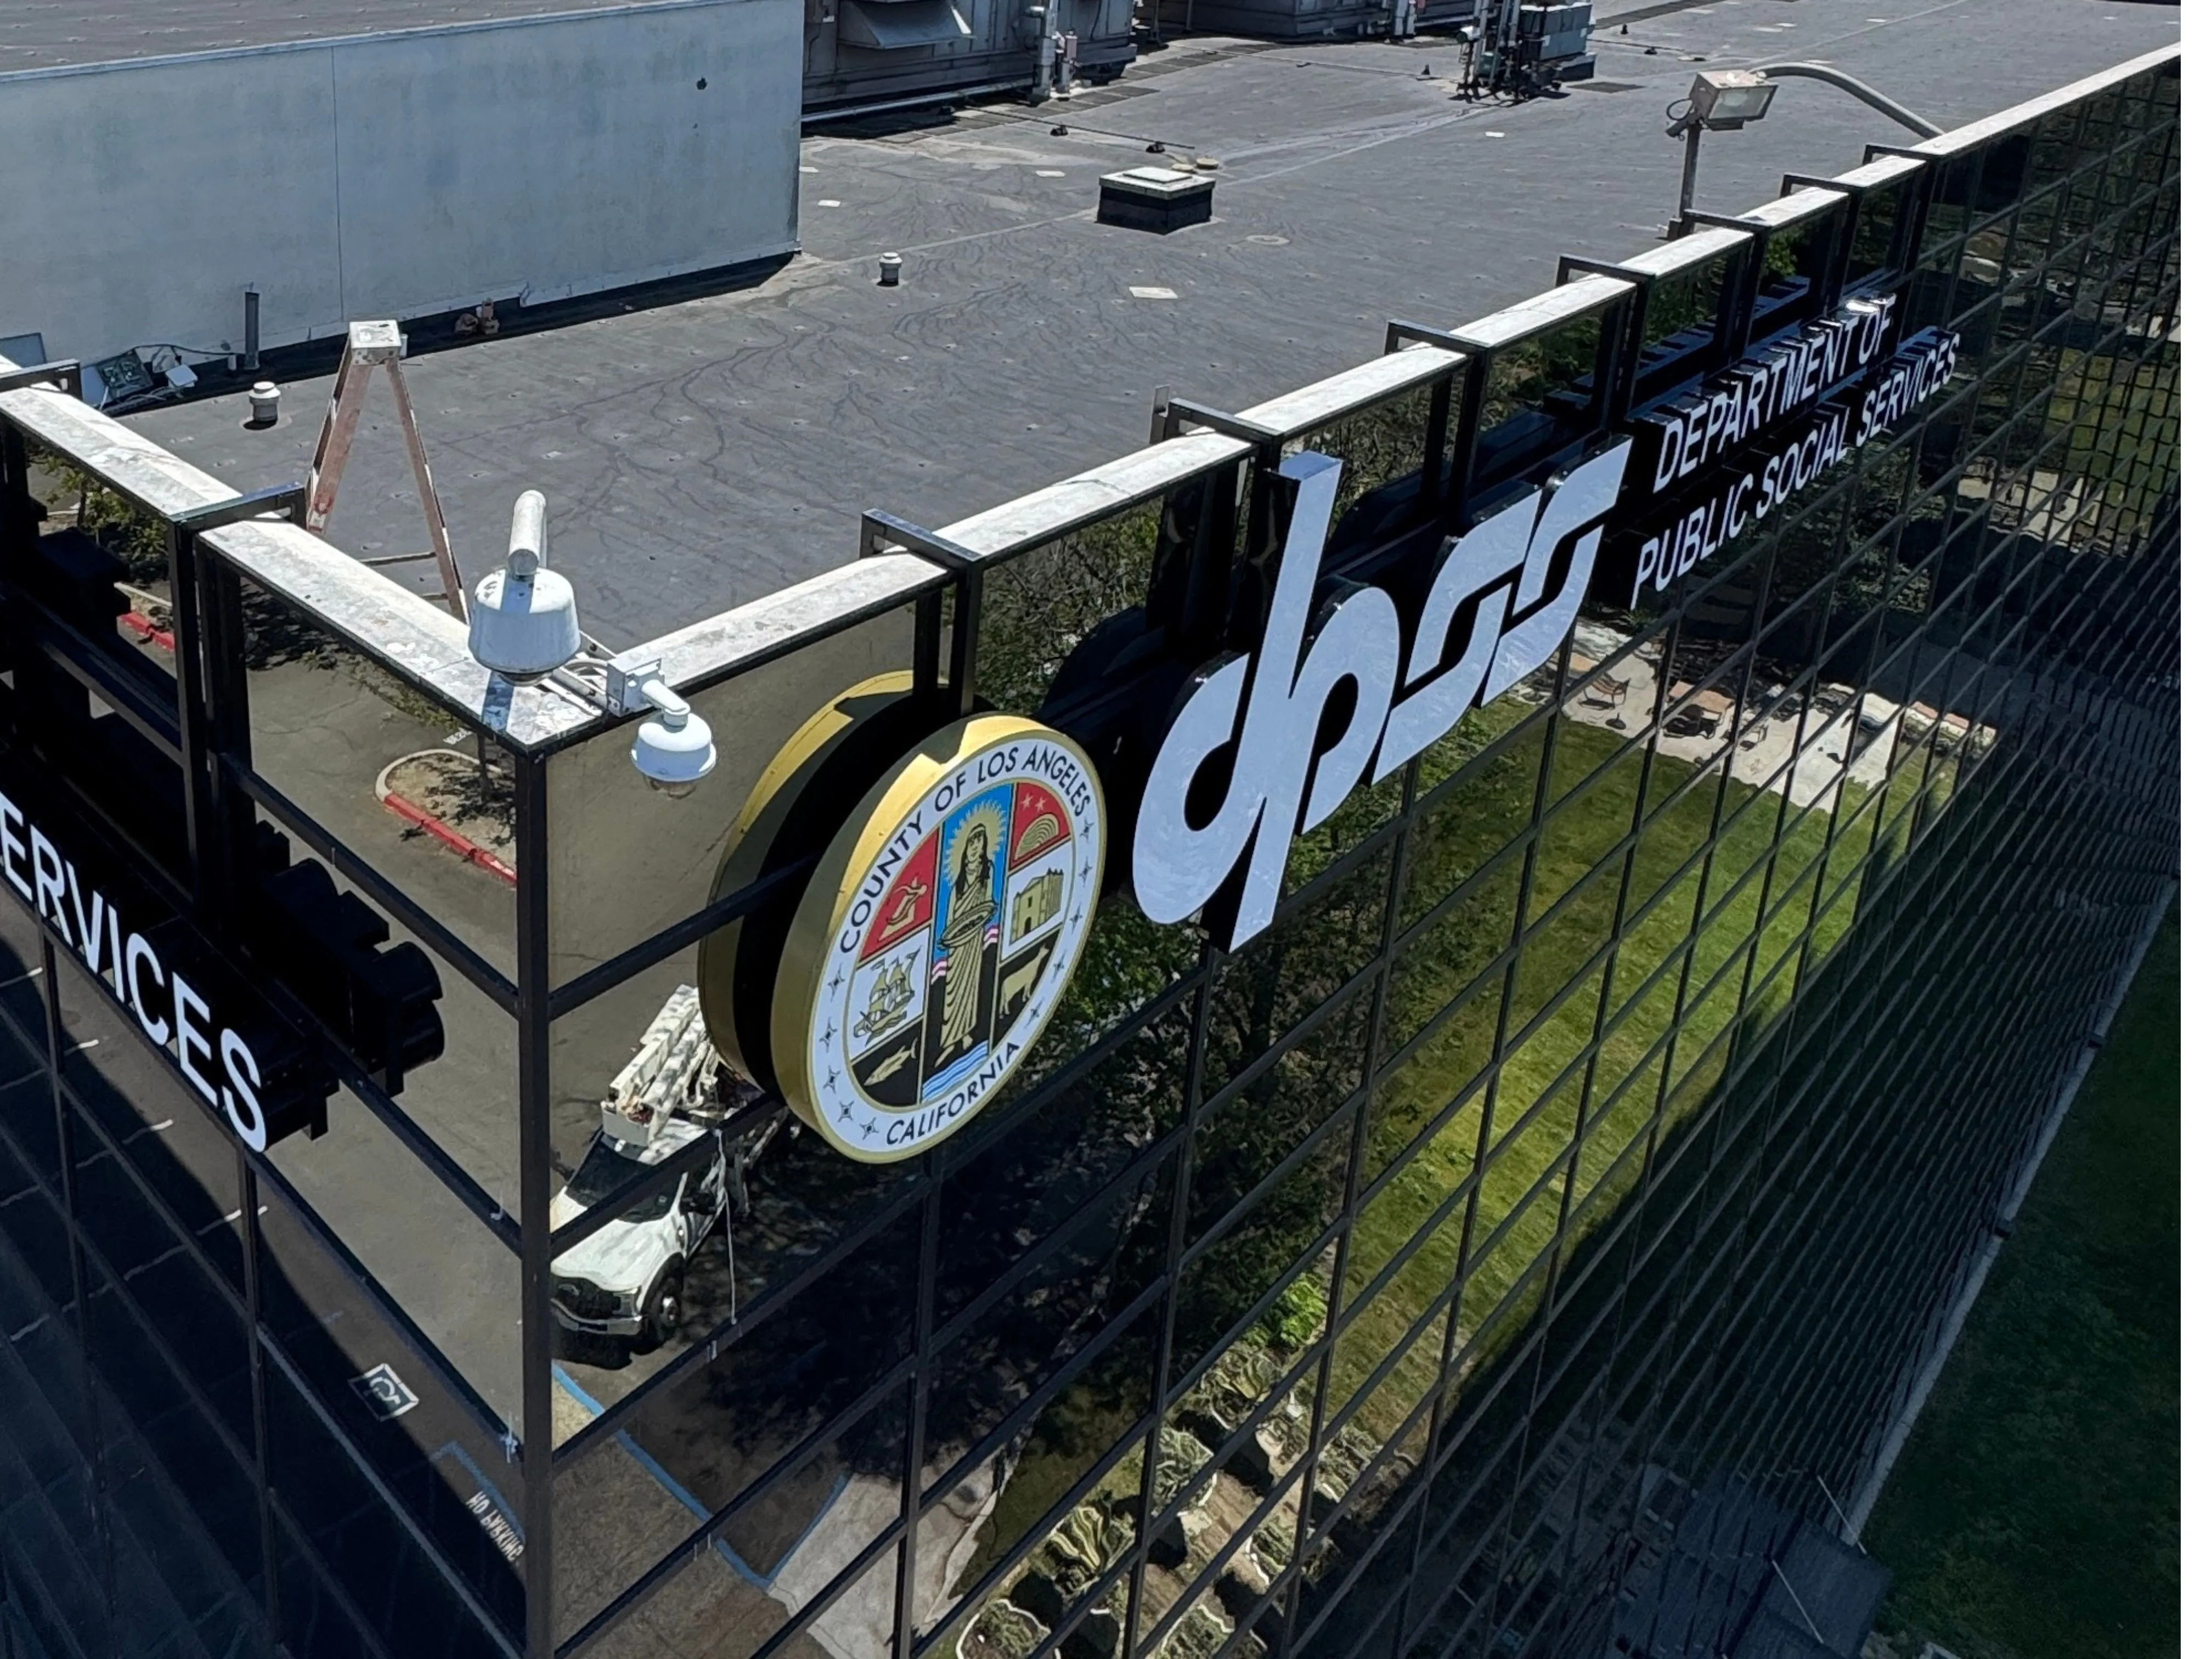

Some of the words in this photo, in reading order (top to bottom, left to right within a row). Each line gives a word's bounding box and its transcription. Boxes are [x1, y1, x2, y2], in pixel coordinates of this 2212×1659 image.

[1630, 473, 1754, 611] PUBLIC
[1756, 407, 1850, 519] SOCIAL
[1855, 332, 1961, 447] SERVICES
[1653, 315, 1859, 493] DEPARTMENT
[1858, 292, 1897, 365] OF
[839, 809, 922, 953] COUNTY
[934, 771, 966, 812] OF
[977, 746, 1019, 785] LOS
[1021, 744, 1091, 817] ANGELES
[886, 1042, 1020, 1145] CALIFORNIA
